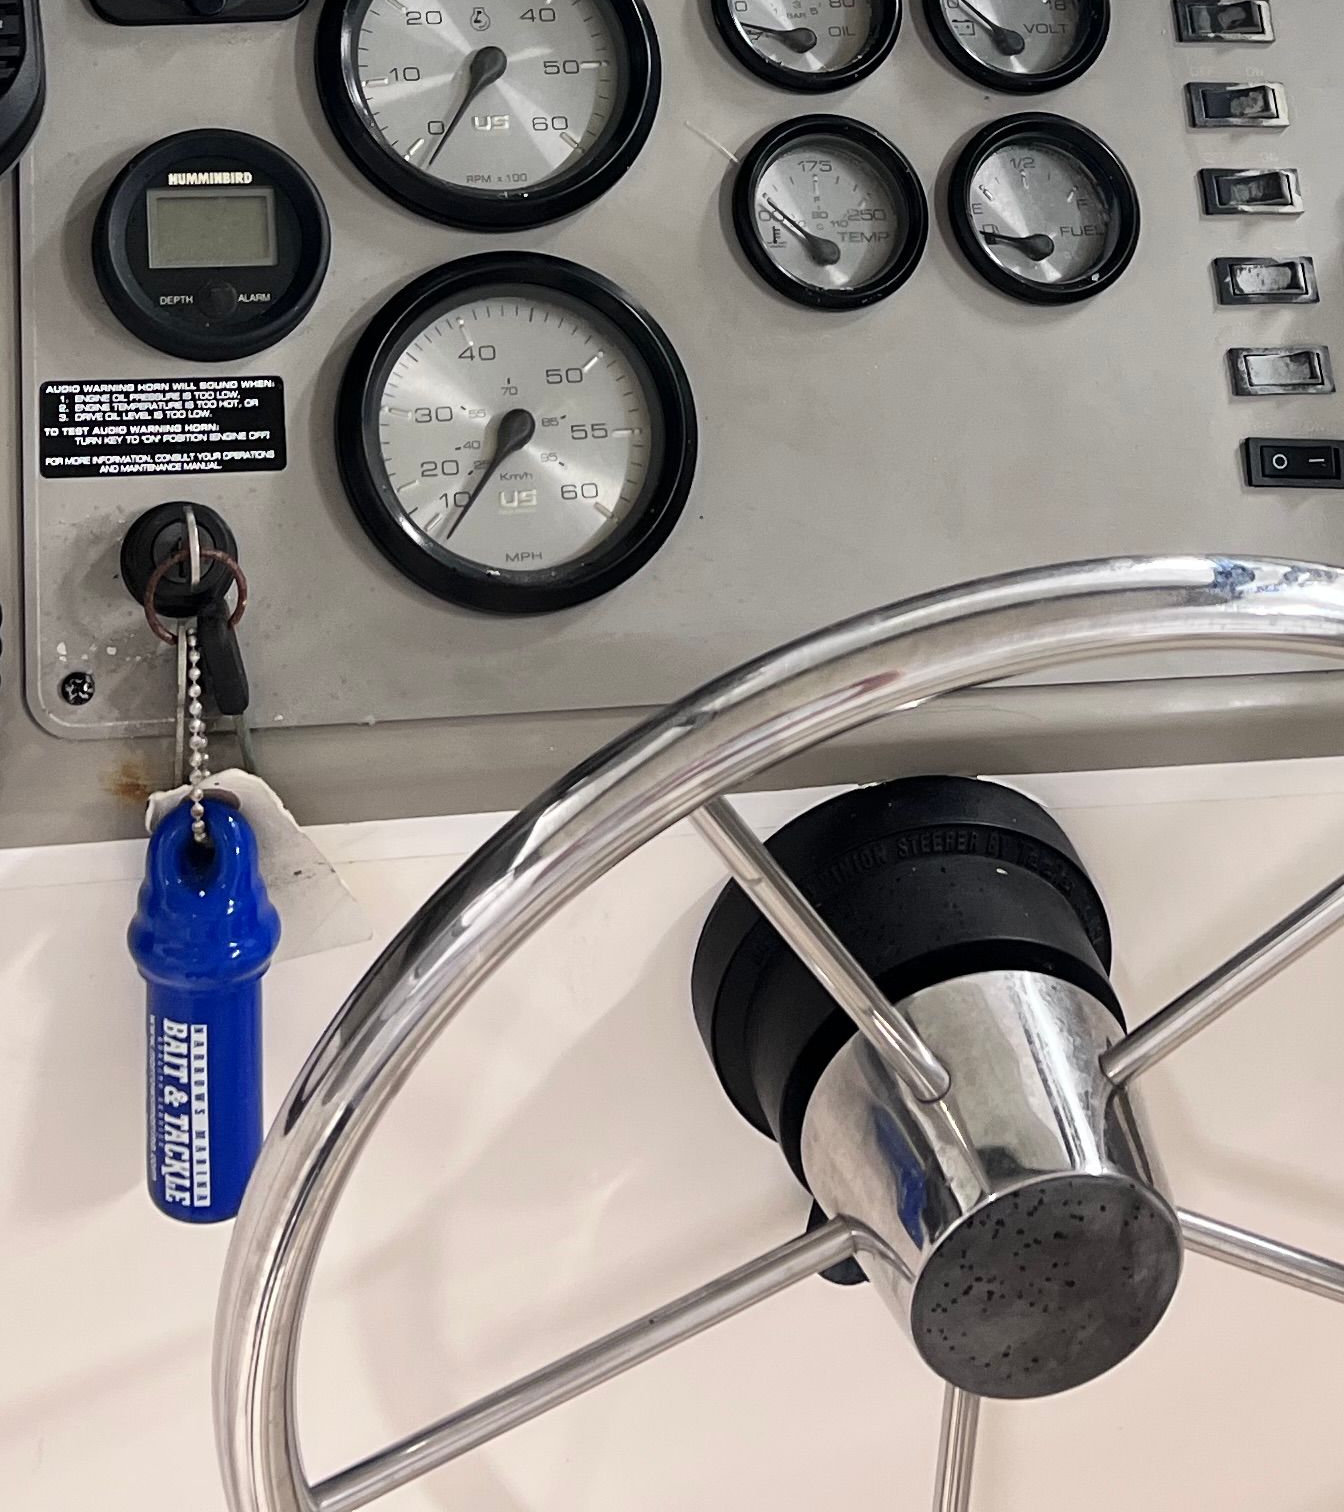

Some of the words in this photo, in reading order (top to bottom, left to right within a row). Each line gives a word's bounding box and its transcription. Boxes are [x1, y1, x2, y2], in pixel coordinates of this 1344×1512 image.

[734, 0, 748, 12] 0
[405, 10, 443, 26] 20
[519, 7, 556, 22] 40
[828, 26, 856, 37] OIL
[1023, 23, 1069, 34] VOLT
[389, 66, 421, 82] 10
[543, 60, 580, 75] 50
[427, 120, 445, 135] 0
[531, 115, 569, 131] 60
[797, 160, 832, 173] 175
[1009, 156, 1036, 169] 1/2
[167, 171, 253, 187] HUMMINBIRD
[466, 173, 492, 184] RPM
[506, 172, 528, 183] 100
[846, 208, 886, 221] 250
[836, 231, 889, 243] TEMP
[1059, 224, 1105, 237] FUEL
[159, 295, 194, 306] DEPTH
[237, 292, 271, 303] ALARM
[457, 345, 497, 362] 40
[545, 367, 584, 384] 50
[45, 384, 81, 394] AUDIO
[82, 383, 135, 393] WARNING
[501, 385, 519, 397] 70
[414, 405, 454, 424] 30
[570, 422, 609, 441] 55
[420, 460, 460, 477] 20
[560, 482, 599, 500] 60
[438, 490, 471, 509] 10
[505, 550, 543, 563] MPH
[163, 1018, 189, 1083] BAIT
[164, 1085, 189, 1108] &
[161, 1113, 190, 1207] TACKLE
